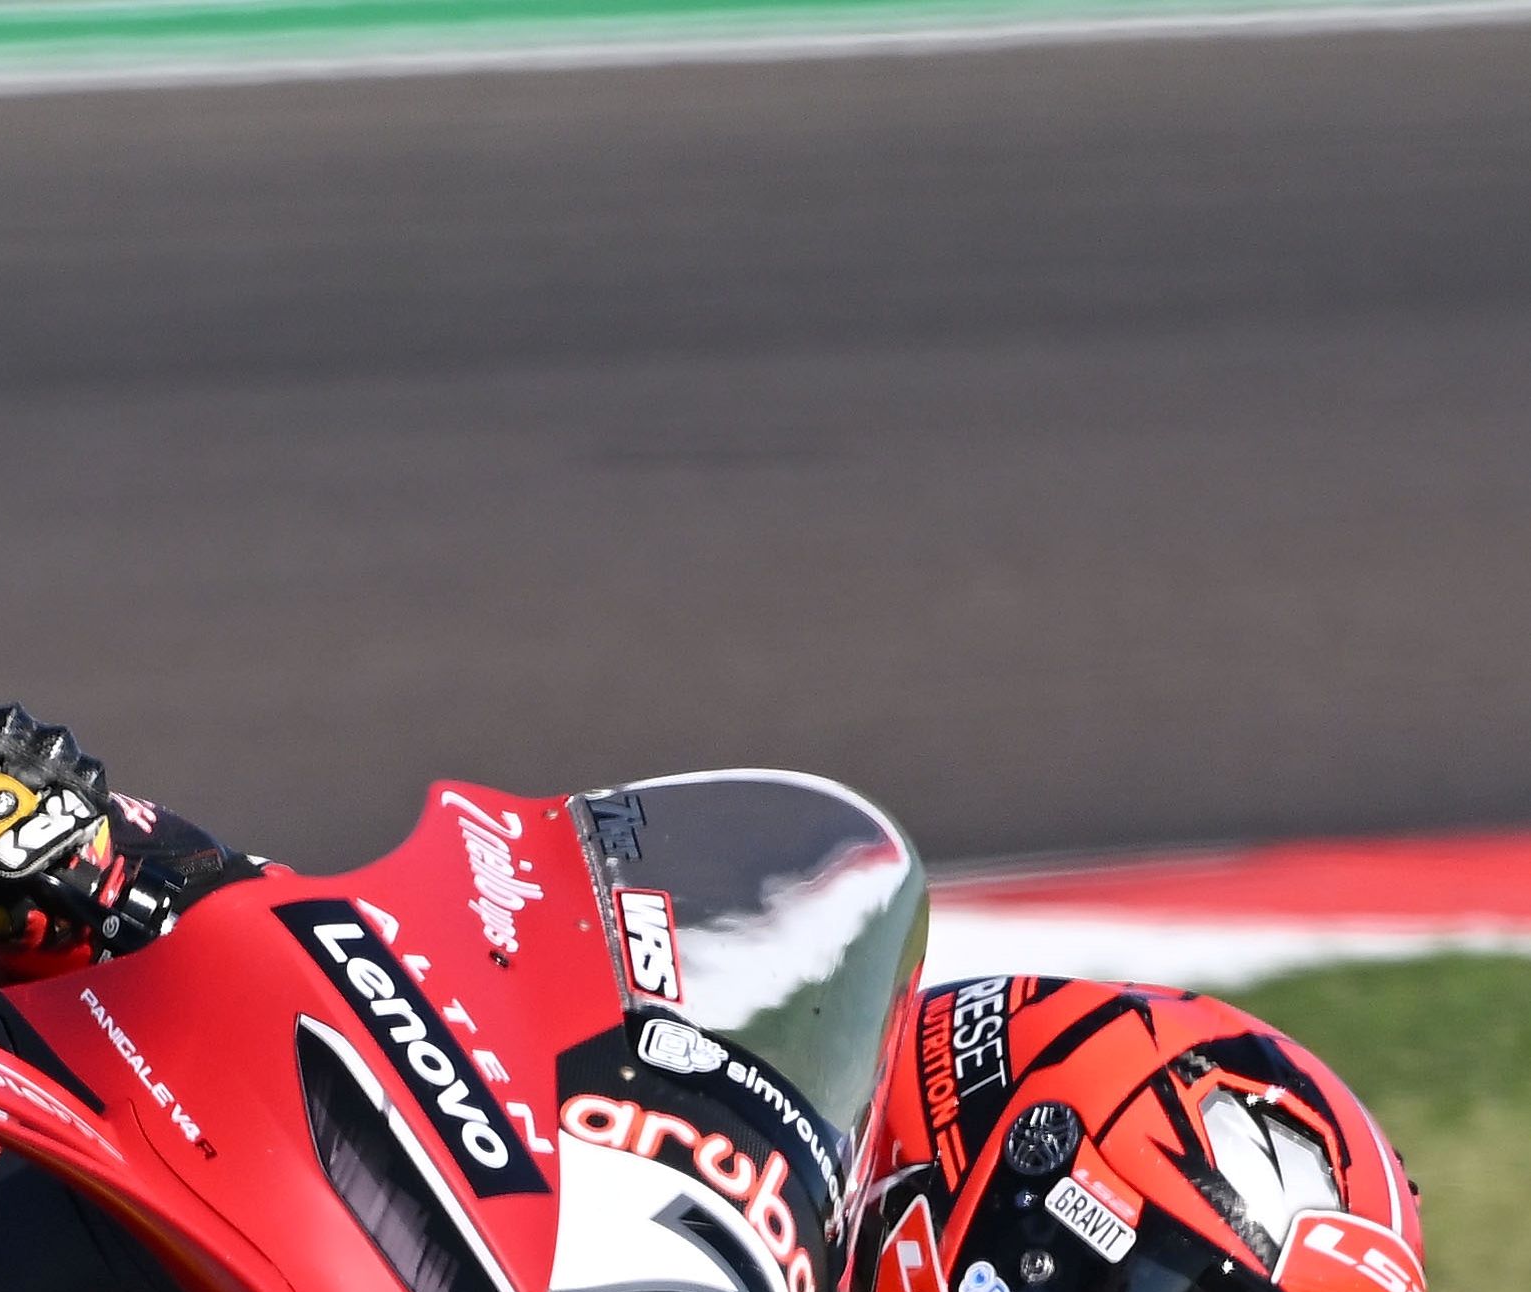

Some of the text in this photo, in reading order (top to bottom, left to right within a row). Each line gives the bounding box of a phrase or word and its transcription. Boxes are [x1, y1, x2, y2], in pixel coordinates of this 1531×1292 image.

[79, 987, 177, 1109] PANIGALE
[167, 1101, 202, 1144] V4
[312, 922, 511, 1171] Lenovo
[355, 897, 556, 1154] ALTEN
[952, 978, 1007, 1098] RESET
[1054, 1186, 1127, 1252] GRAVIT
